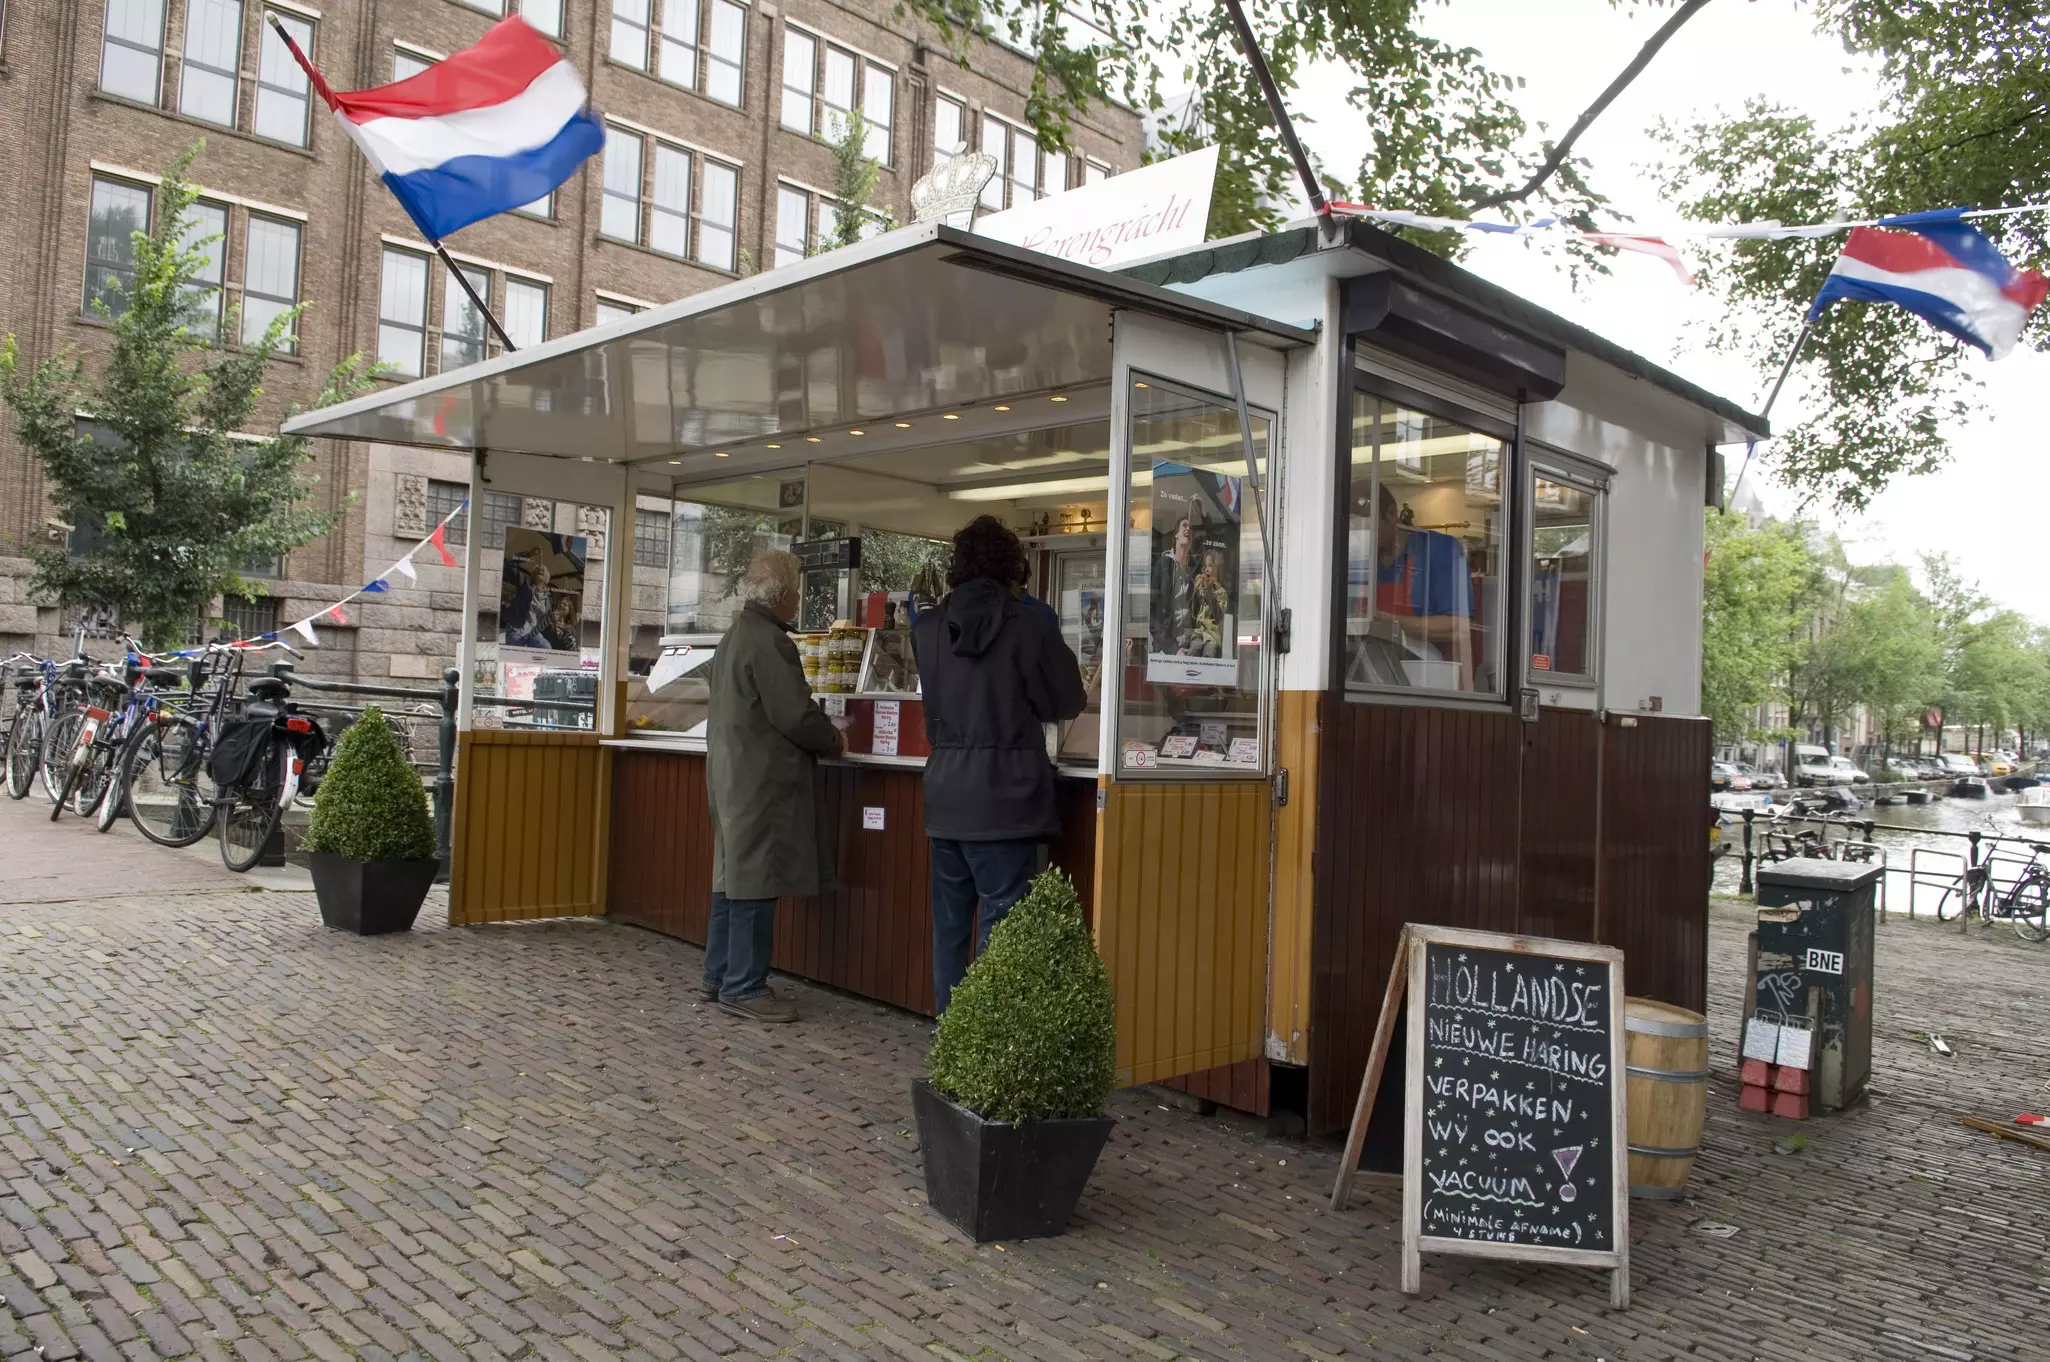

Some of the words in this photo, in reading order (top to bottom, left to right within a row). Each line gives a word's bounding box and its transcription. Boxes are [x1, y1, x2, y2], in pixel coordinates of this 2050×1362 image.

[1808, 950, 1841, 972] BNE
[1431, 955, 1602, 1026] HOLLANDSE
[1427, 1075, 1573, 1124] VERPAKKEN
[1484, 1128, 1536, 1152] OOK
[1453, 1226, 1463, 1238] 4
[1468, 1229, 1516, 1242] STUKS
